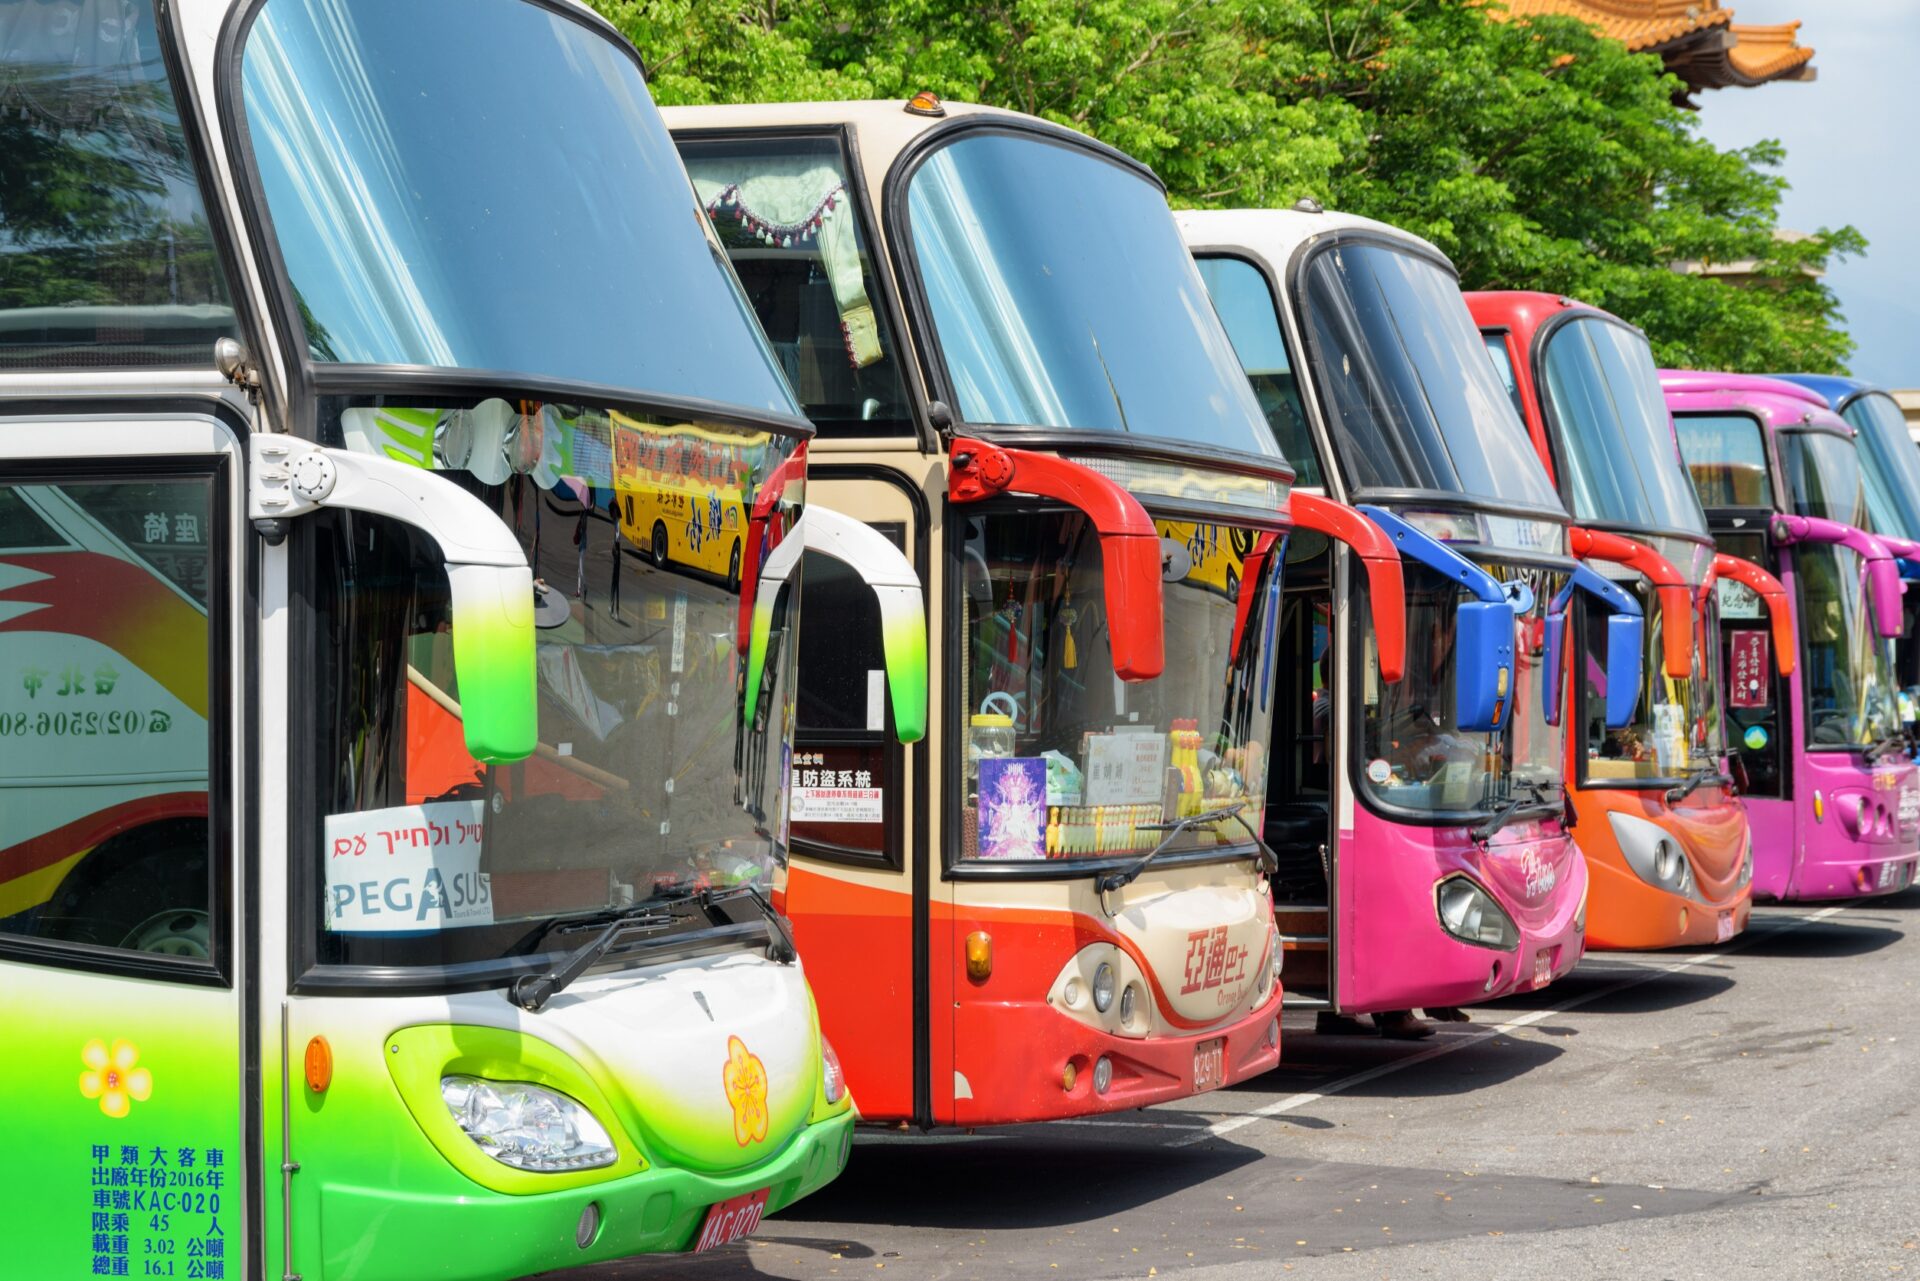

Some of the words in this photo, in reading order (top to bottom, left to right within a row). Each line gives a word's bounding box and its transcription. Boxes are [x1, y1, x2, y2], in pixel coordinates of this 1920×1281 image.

[333, 832, 367, 859] עם
[332, 867, 489, 921] PEGASUS
[1181, 925, 1248, 996] 亞通巴士
[92, 1144, 224, 1168] 甲類大客車
[92, 1166, 224, 1190] 出廠年份2016年
[92, 1212, 129, 1232] 限乘
[150, 1214, 169, 1231] 45
[206, 1216, 224, 1236] 人
[92, 1233, 129, 1255] 載重
[144, 1238, 175, 1254] 3.02
[187, 1237, 224, 1258] 公噸
[92, 1255, 129, 1276] 總重
[144, 1260, 174, 1276] 16.1
[187, 1259, 224, 1280] 公噸
